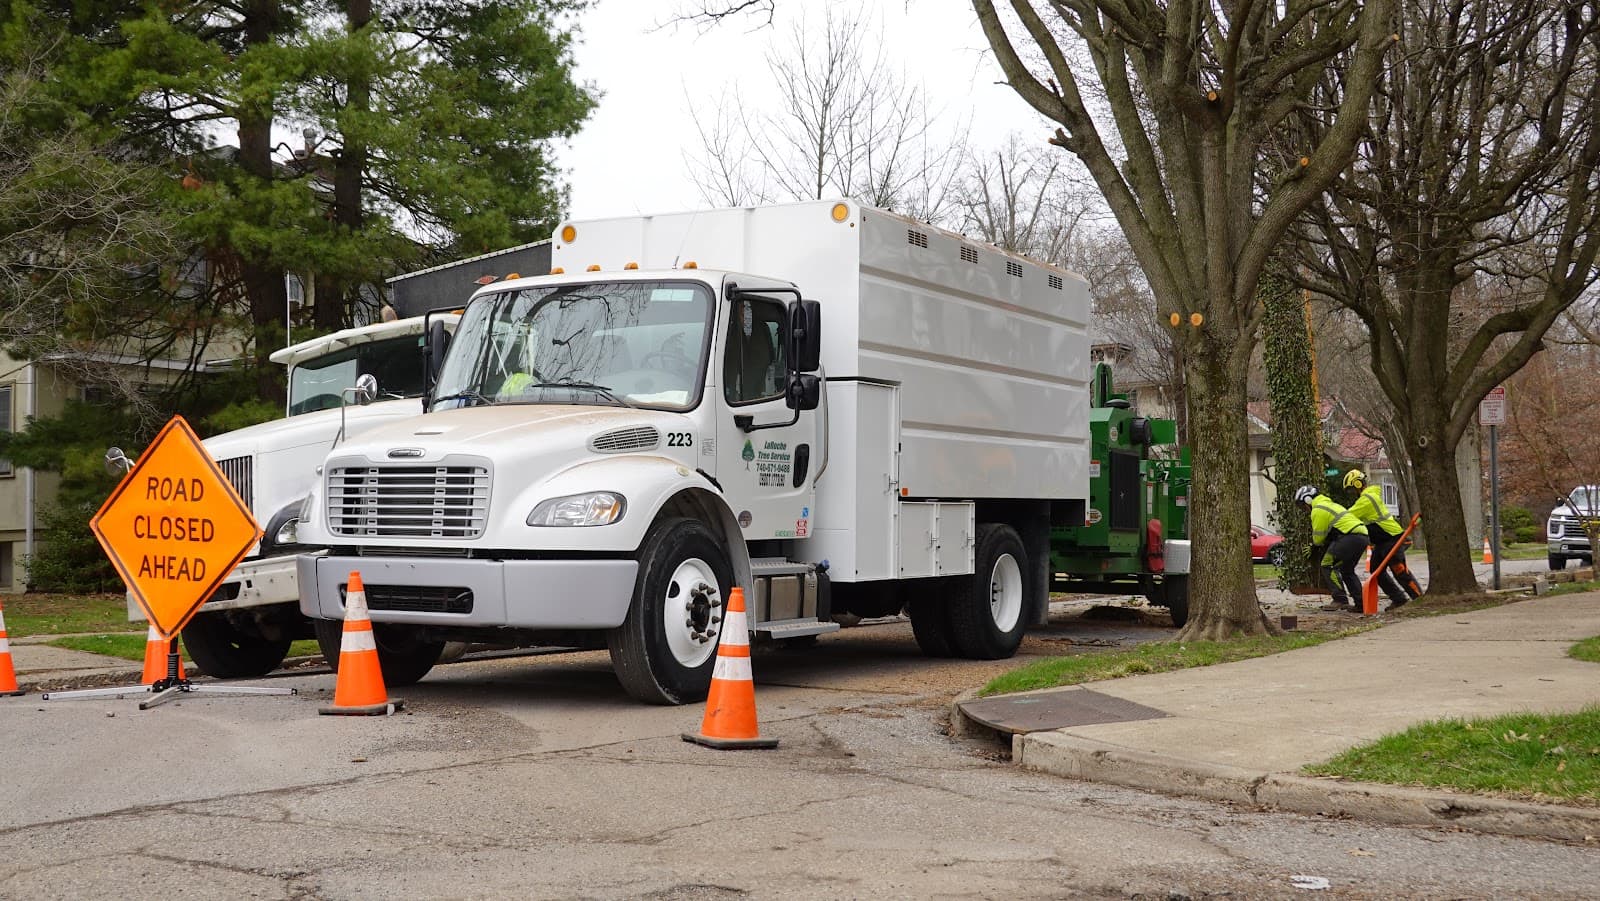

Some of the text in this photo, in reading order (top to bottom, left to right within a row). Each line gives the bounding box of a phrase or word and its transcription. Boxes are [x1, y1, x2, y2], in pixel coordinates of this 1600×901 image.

[667, 432, 693, 447] 223
[764, 440, 787, 450] LaRoche
[758, 451, 791, 461] Tree Service
[146, 476, 205, 502] ROAD
[133, 515, 215, 543] CLOSED
[138, 554, 206, 582] AHEAD
